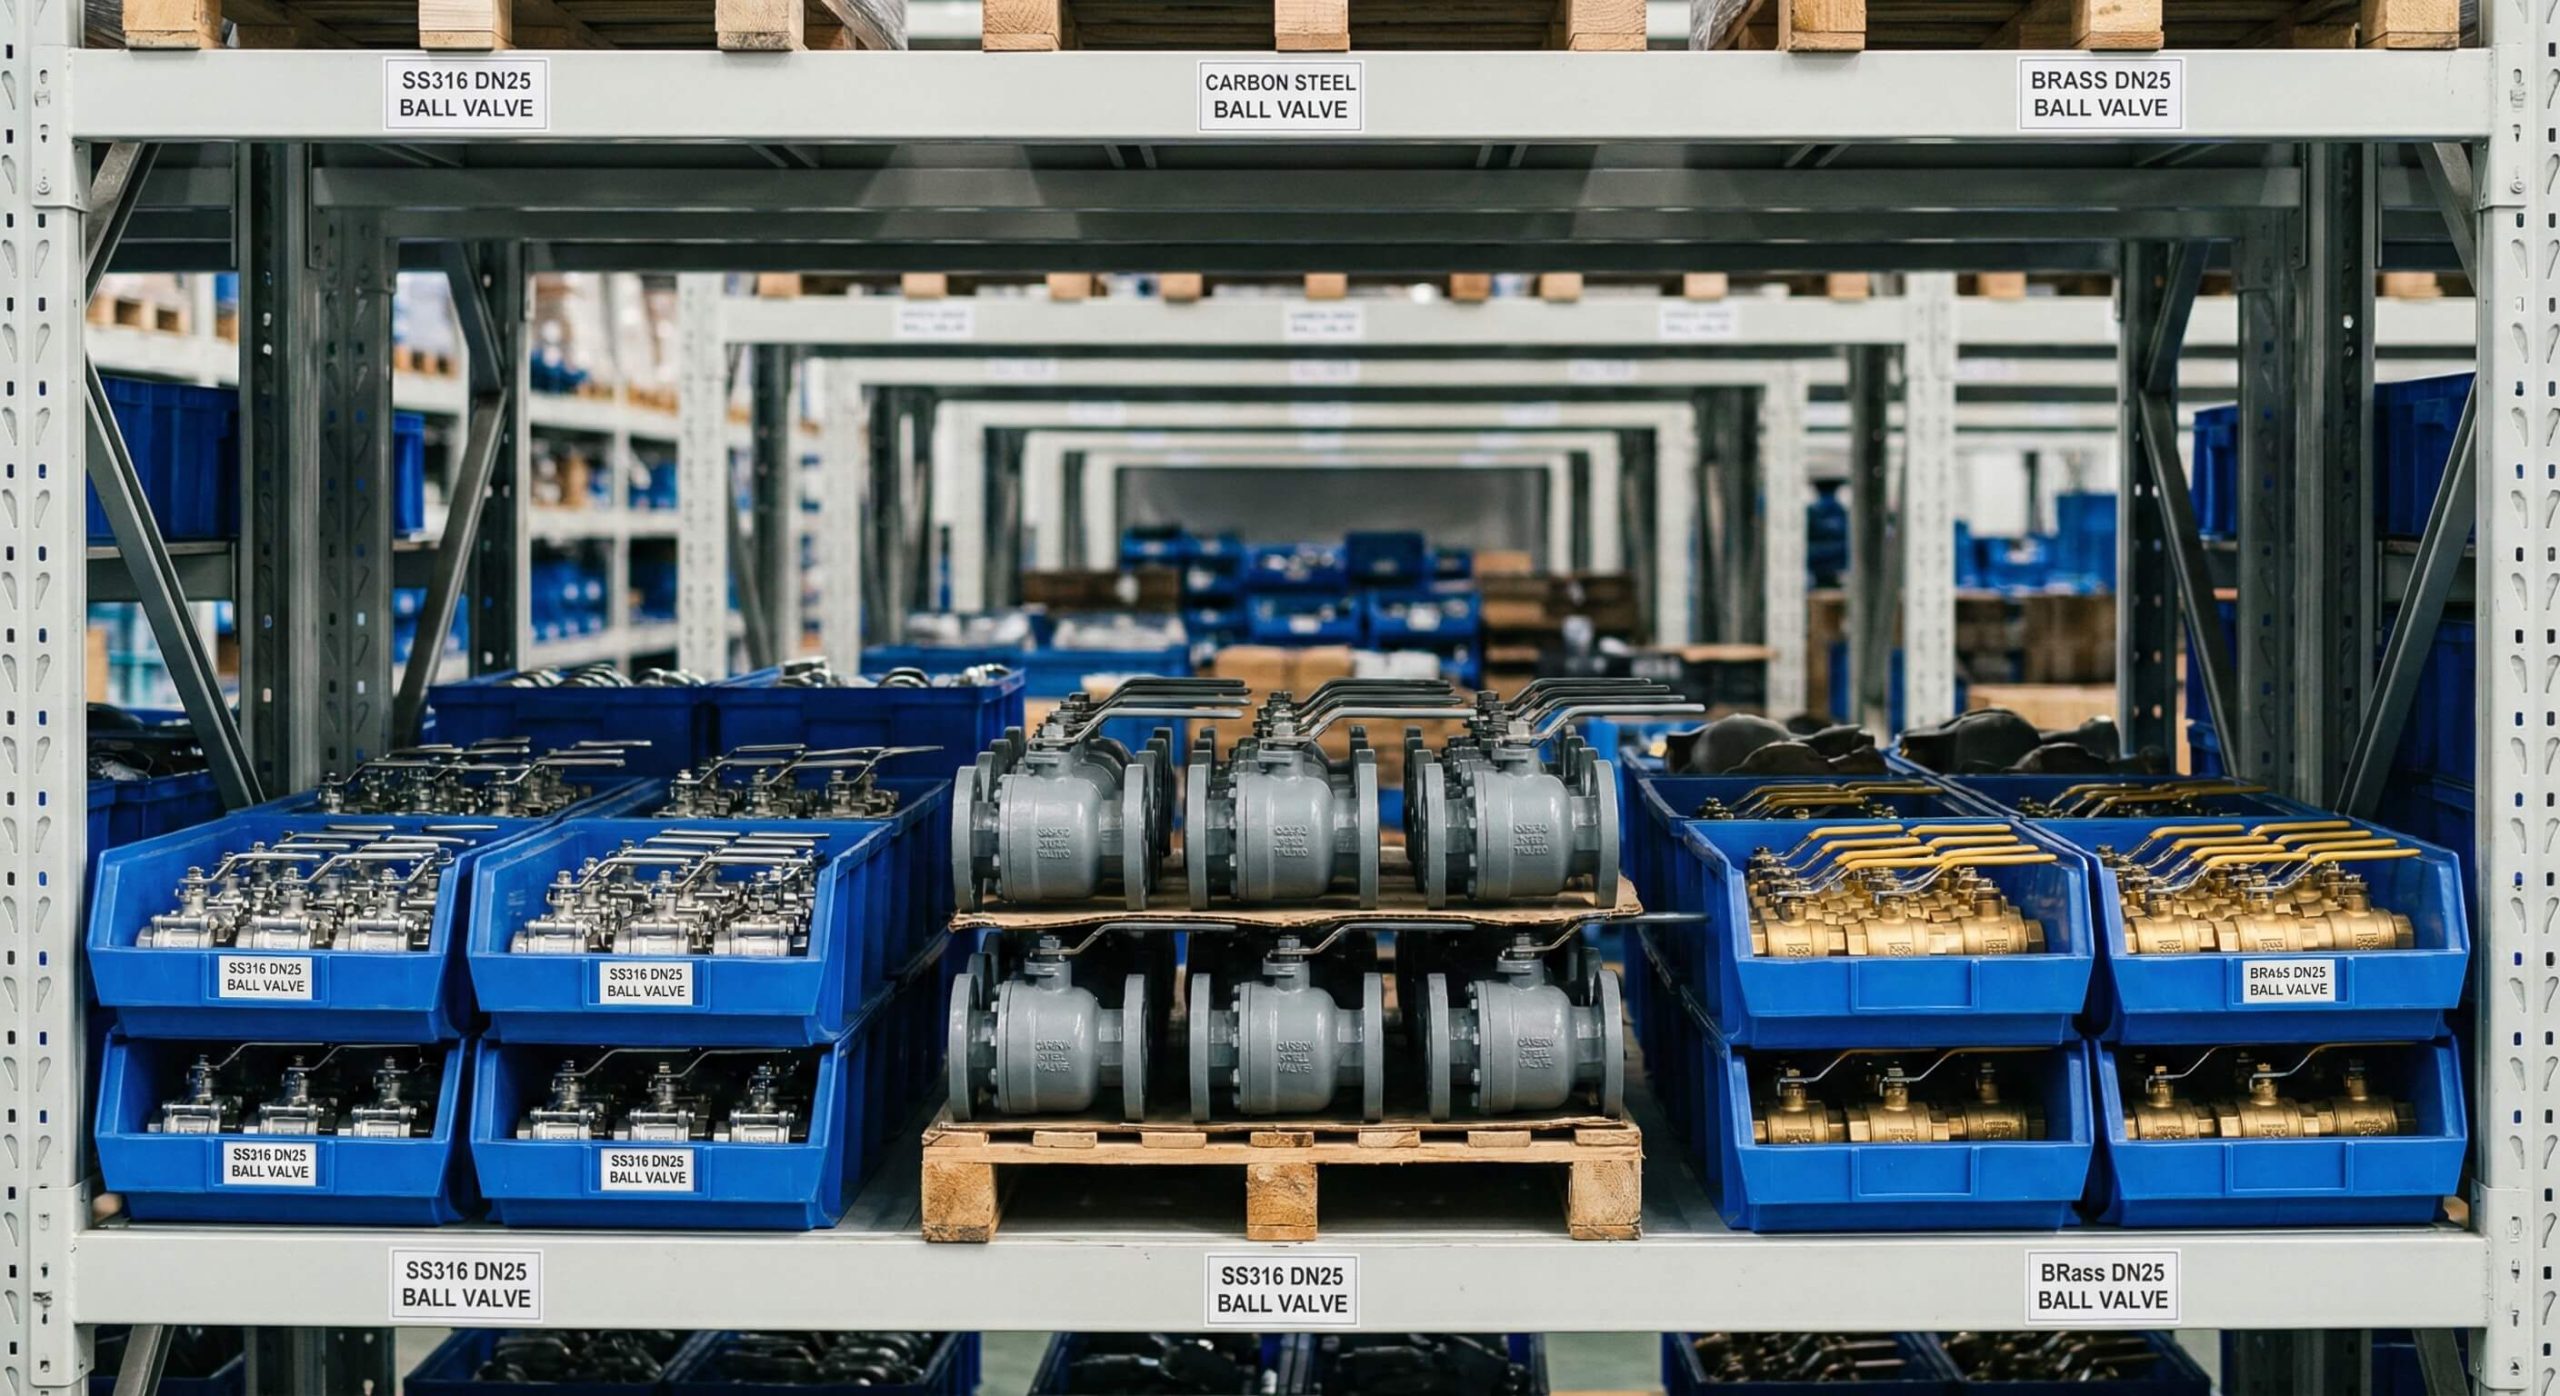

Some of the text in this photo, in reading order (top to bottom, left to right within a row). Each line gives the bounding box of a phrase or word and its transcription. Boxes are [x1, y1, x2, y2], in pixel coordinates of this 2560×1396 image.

[402, 70, 531, 90] SS316 DN25
[1205, 73, 1357, 92] CARBON STEEL
[2031, 70, 2171, 90] BRASS DN25
[400, 98, 533, 117] BALL VALVE
[1214, 100, 1348, 119] BALL VALVE
[2034, 98, 2168, 117] BALL VALVE
[228, 961, 302, 976] SS316 DN25
[609, 967, 683, 981] SS316 DN25
[2293, 966, 2326, 979] DN25
[227, 978, 305, 993] BALL VALVE
[607, 984, 686, 998] BALL VALVE
[2250, 982, 2328, 996] BALL VALVE
[233, 1147, 307, 1162] SS316 DN25
[611, 1154, 684, 1168] SS316 DN25
[231, 1164, 309, 1179] BALL VALVE
[609, 1170, 687, 1184] BALL VALVE
[406, 1260, 527, 1282] SS316 DN25
[1221, 1265, 1344, 1286] SS316 DN25
[2041, 1262, 2165, 1282] BRass DN25
[402, 1287, 531, 1308] BALL VALVE
[1218, 1293, 1348, 1314] BALL VALVE
[2038, 1290, 2169, 1310] BALL VALVE
